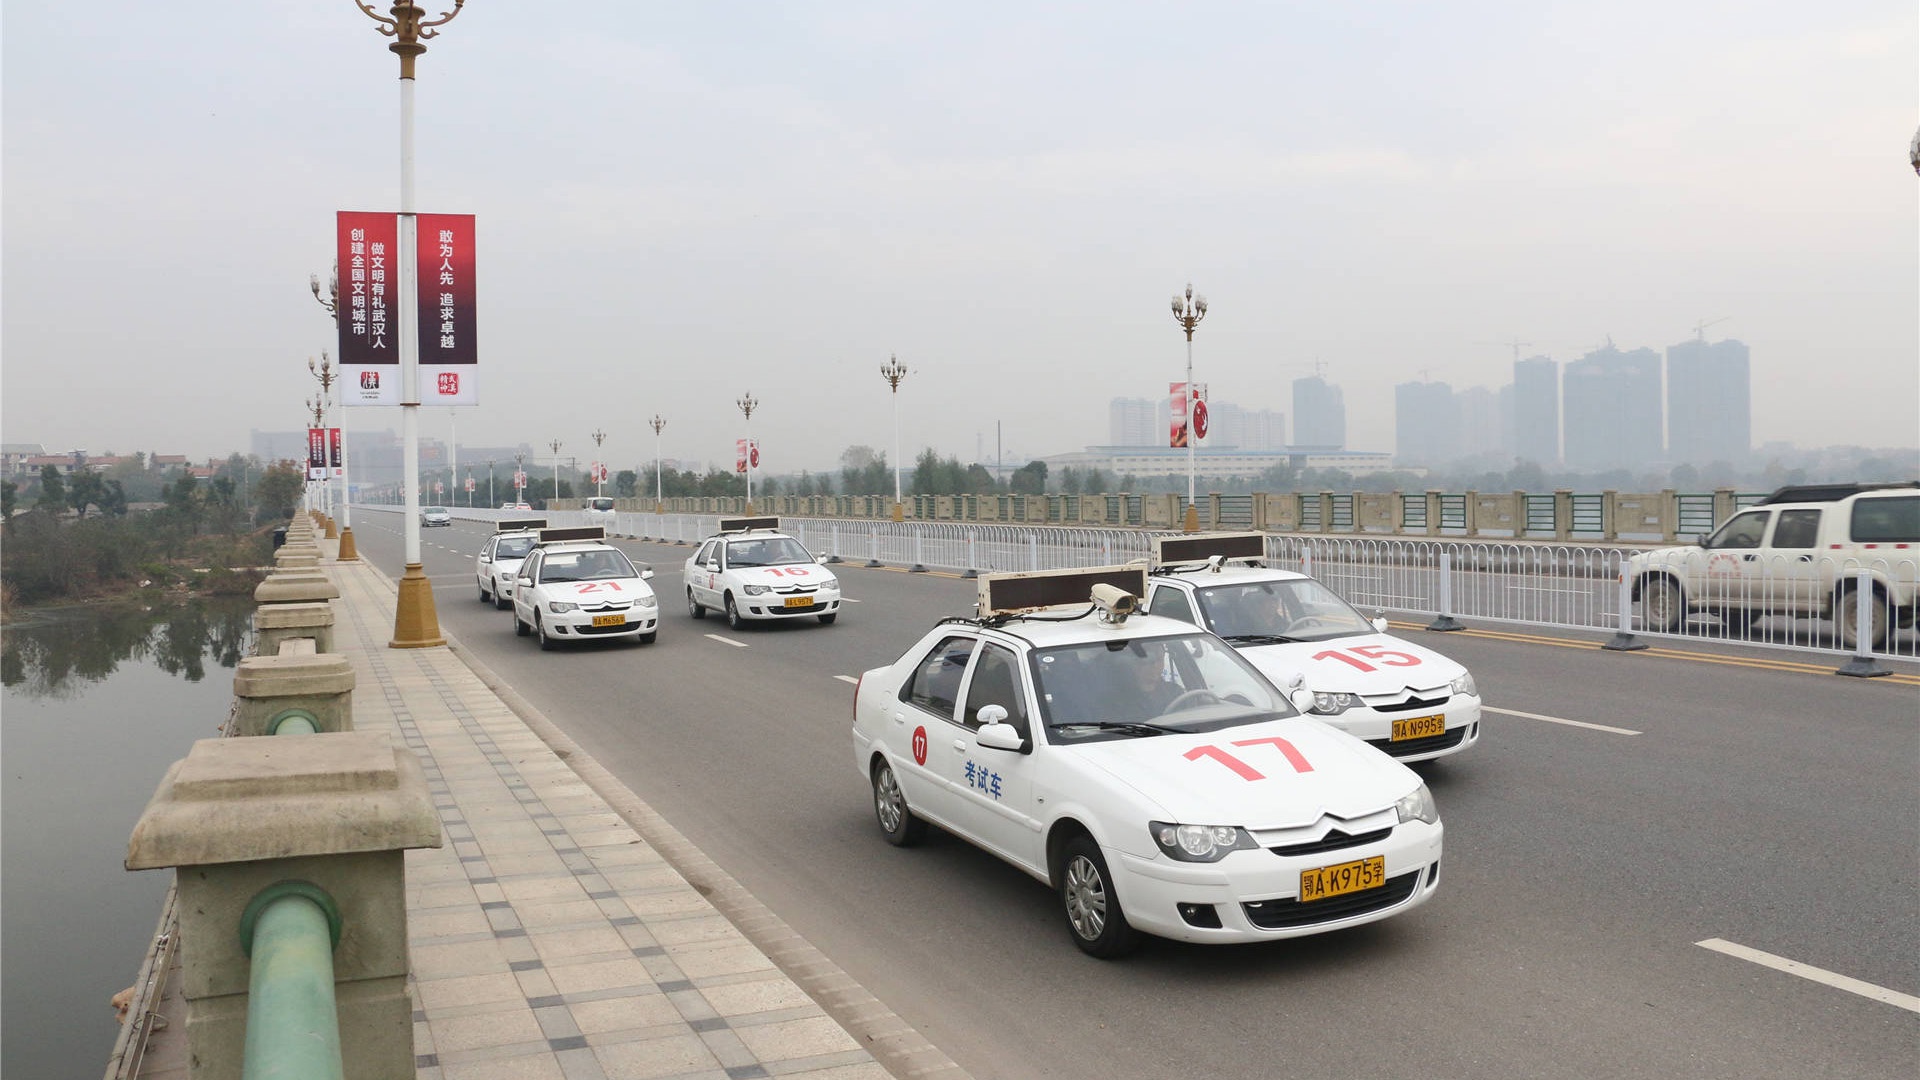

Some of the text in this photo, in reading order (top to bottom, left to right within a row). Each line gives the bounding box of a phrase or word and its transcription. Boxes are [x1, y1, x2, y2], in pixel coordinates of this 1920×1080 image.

[350, 228, 366, 335] 创建全国文明城市
[370, 242, 386, 349] 做文明有礼武汉人
[439, 229, 455, 349] 敢为人先 追求卓越
[574, 581, 623, 594] 21
[764, 567, 809, 577] 16
[1312, 645, 1422, 673] 15
[914, 735, 926, 759] 17
[1182, 736, 1315, 782] 17
[964, 761, 1002, 800] 考试车
